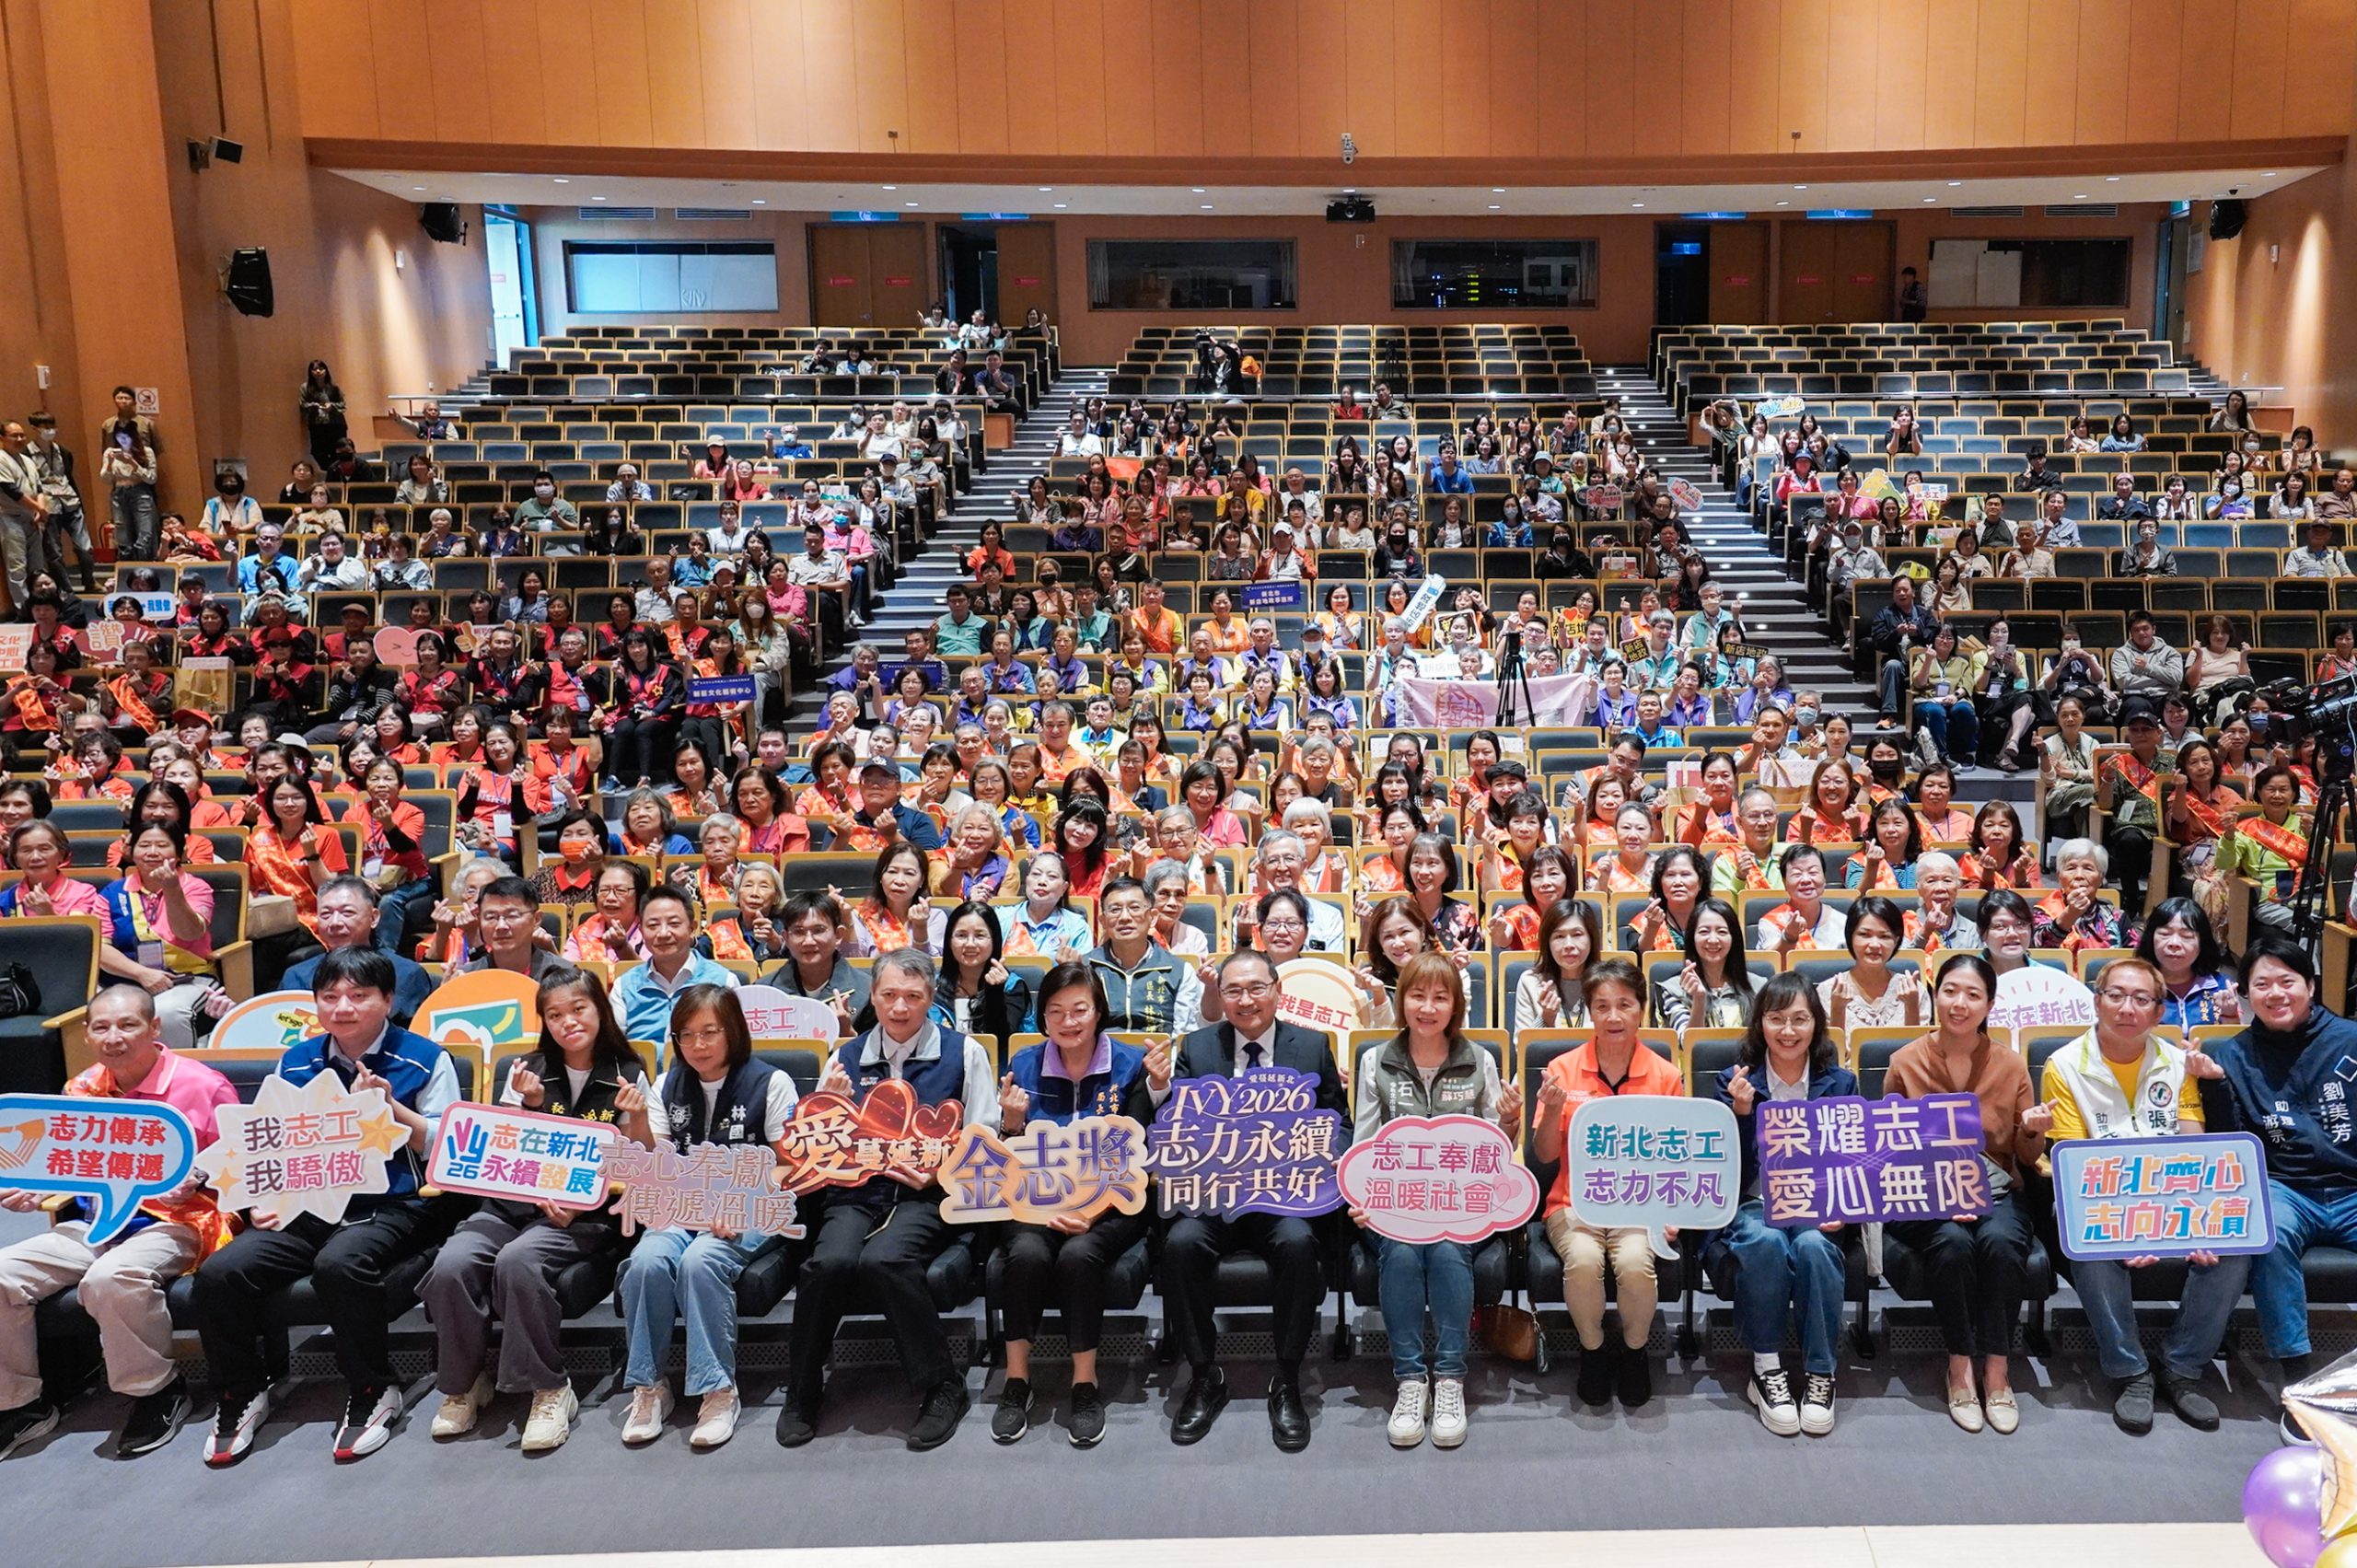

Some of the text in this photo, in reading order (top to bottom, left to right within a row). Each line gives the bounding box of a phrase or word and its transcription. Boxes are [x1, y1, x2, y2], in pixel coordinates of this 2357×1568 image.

[744, 1007, 795, 1032] 志工
[1277, 993, 1352, 1030] 我是志工
[48, 1113, 167, 1146] 志力傳承
[244, 1109, 361, 1151] 我志工
[489, 1123, 601, 1163] 志在新北
[1138, 1115, 1335, 1174] 志力永續
[1585, 1122, 1724, 1160] 新北志工
[1764, 1100, 1979, 1158] 榮耀志工
[47, 1147, 165, 1181] 希望傳遞
[245, 1150, 363, 1194] 我驕傲
[481, 1154, 598, 1195] 永續發展
[598, 1139, 776, 1194] 志心奉獻
[949, 1126, 1136, 1212] 金志獎
[1372, 1141, 1502, 1175] 志工奉獻
[2080, 1151, 2244, 1196] 新北齊心
[1163, 1166, 1327, 1213] 同行共好
[1364, 1178, 1494, 1214] 溫暖社會
[1583, 1167, 1725, 1207] 志力不凡
[1768, 1159, 1987, 1221] 愛心無限
[610, 1183, 803, 1237] 傳遞溫暖
[2083, 1197, 2248, 1242] 志向永續
